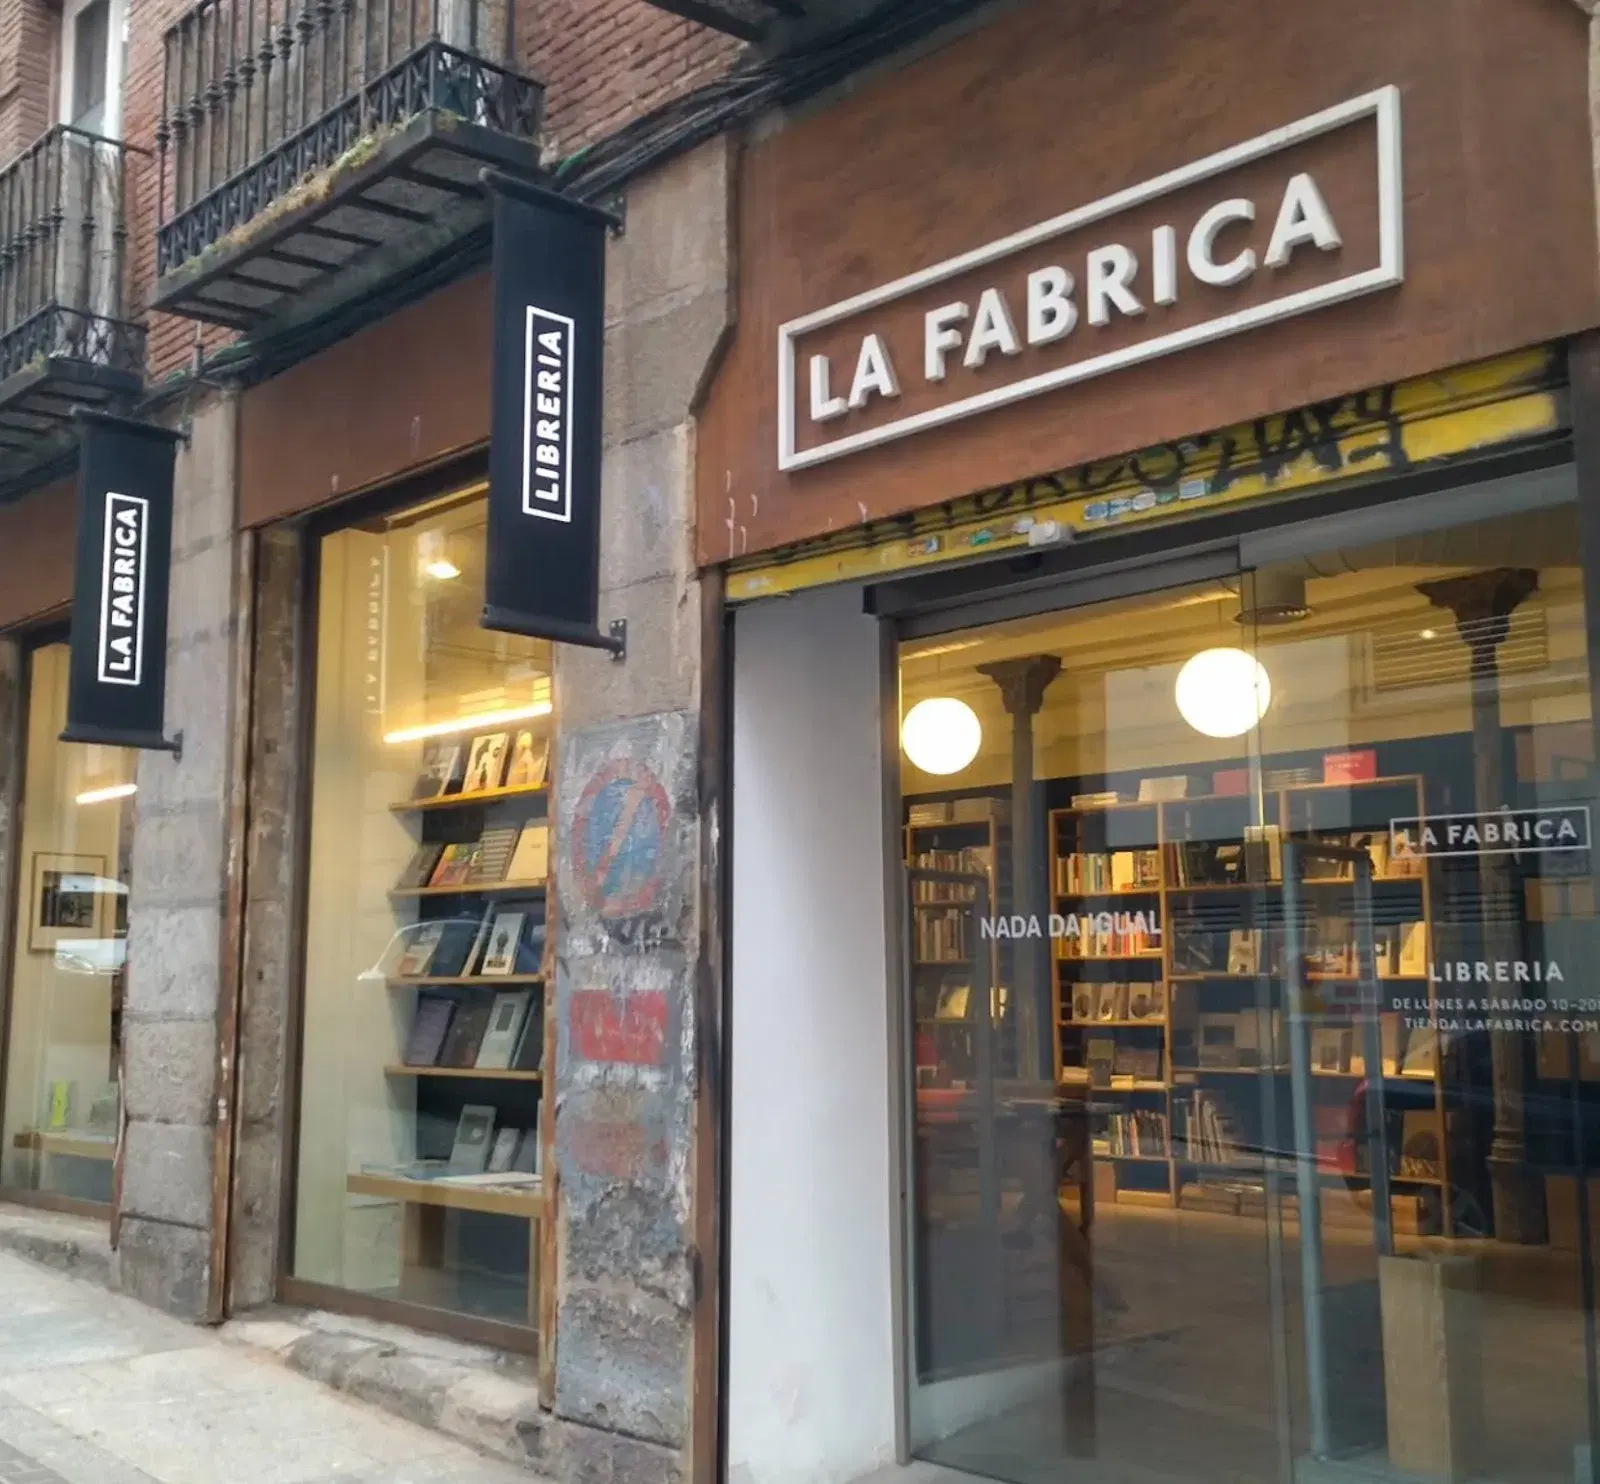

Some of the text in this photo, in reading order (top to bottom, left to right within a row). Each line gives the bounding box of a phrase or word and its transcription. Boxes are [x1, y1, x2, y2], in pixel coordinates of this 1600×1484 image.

[809, 172, 1344, 424] LA FABRICA
[535, 331, 562, 502] LIBRERIA
[109, 508, 138, 672] LA FABRICA
[1402, 818, 1578, 846] LA FABRICA
[980, 910, 1162, 939] NADA DA IGUAL
[1429, 961, 1564, 982] LIBRERIA
[1392, 998, 1411, 1010] DE
[1414, 998, 1463, 1010] LUNES
[1466, 998, 1478, 1011] A
